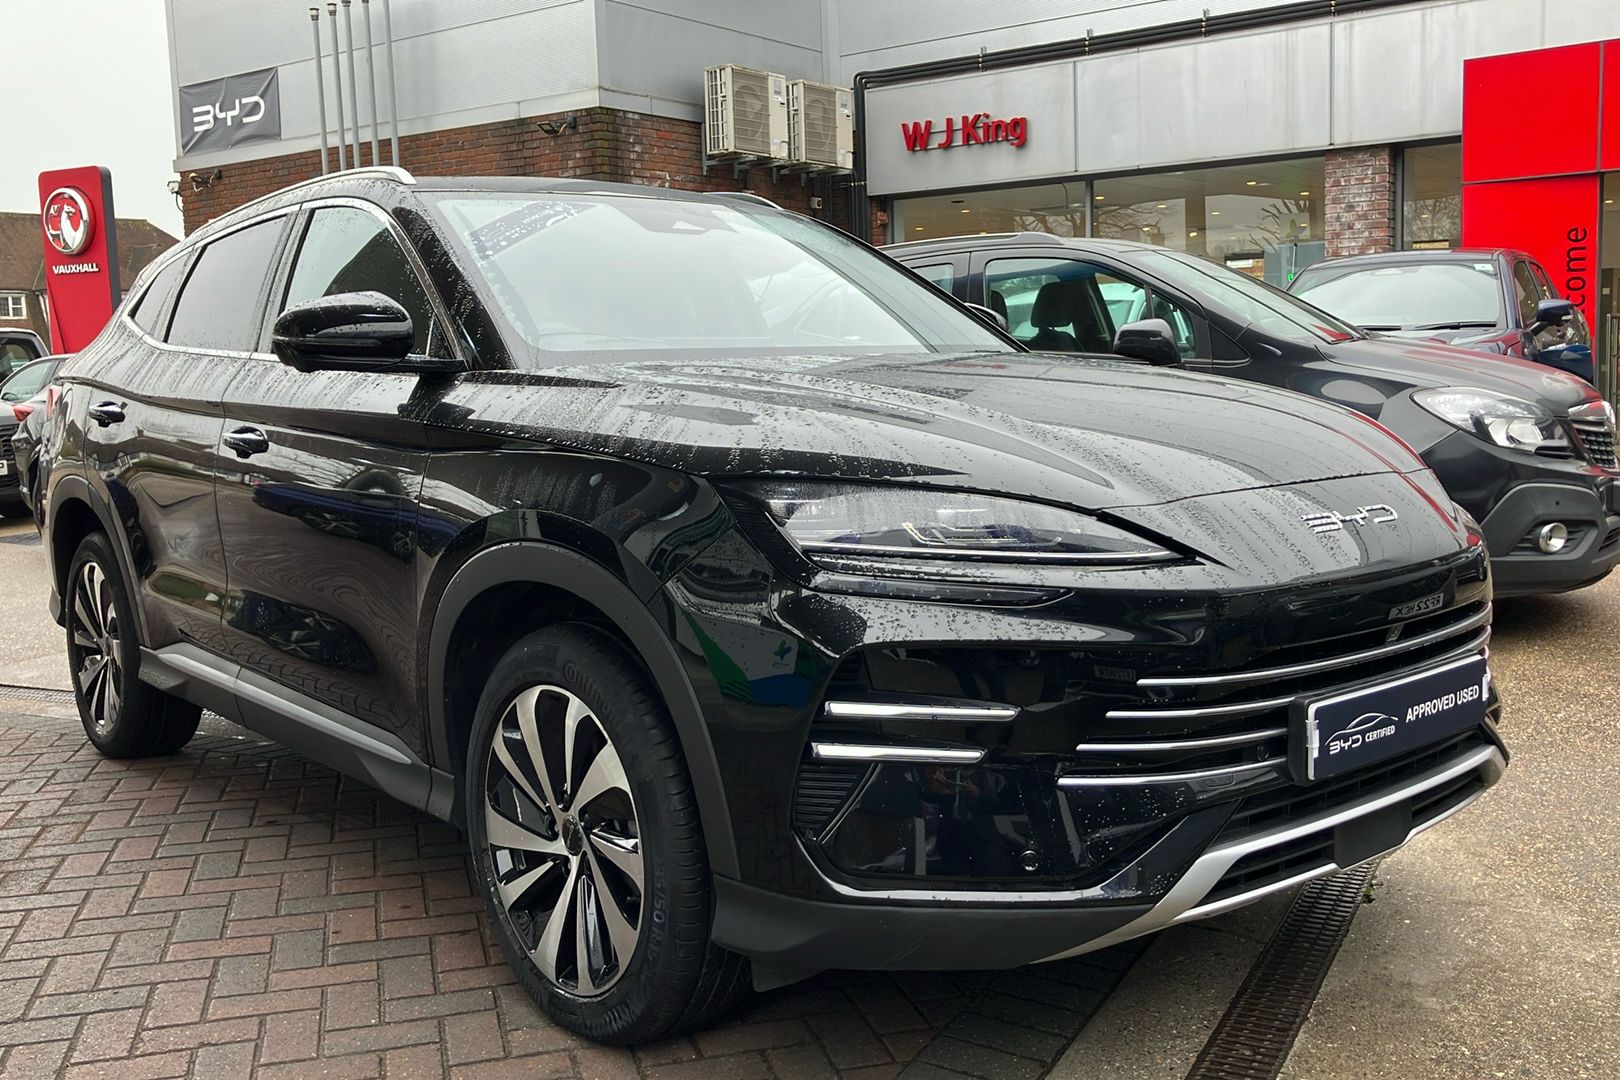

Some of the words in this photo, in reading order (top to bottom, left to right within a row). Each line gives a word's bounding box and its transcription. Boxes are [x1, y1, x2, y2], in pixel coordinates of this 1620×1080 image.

[192, 95, 265, 132] BYD
[901, 120, 932, 151] W
[938, 117, 954, 149] J
[961, 112, 1027, 148] King
[52, 262, 99, 274] VAUXHALL
[1300, 504, 1398, 534] BYD
[1405, 693, 1456, 723] APPROVED
[1456, 684, 1480, 705] USED
[1329, 734, 1363, 755] BYD
[1365, 725, 1396, 742] CERTIFIED
